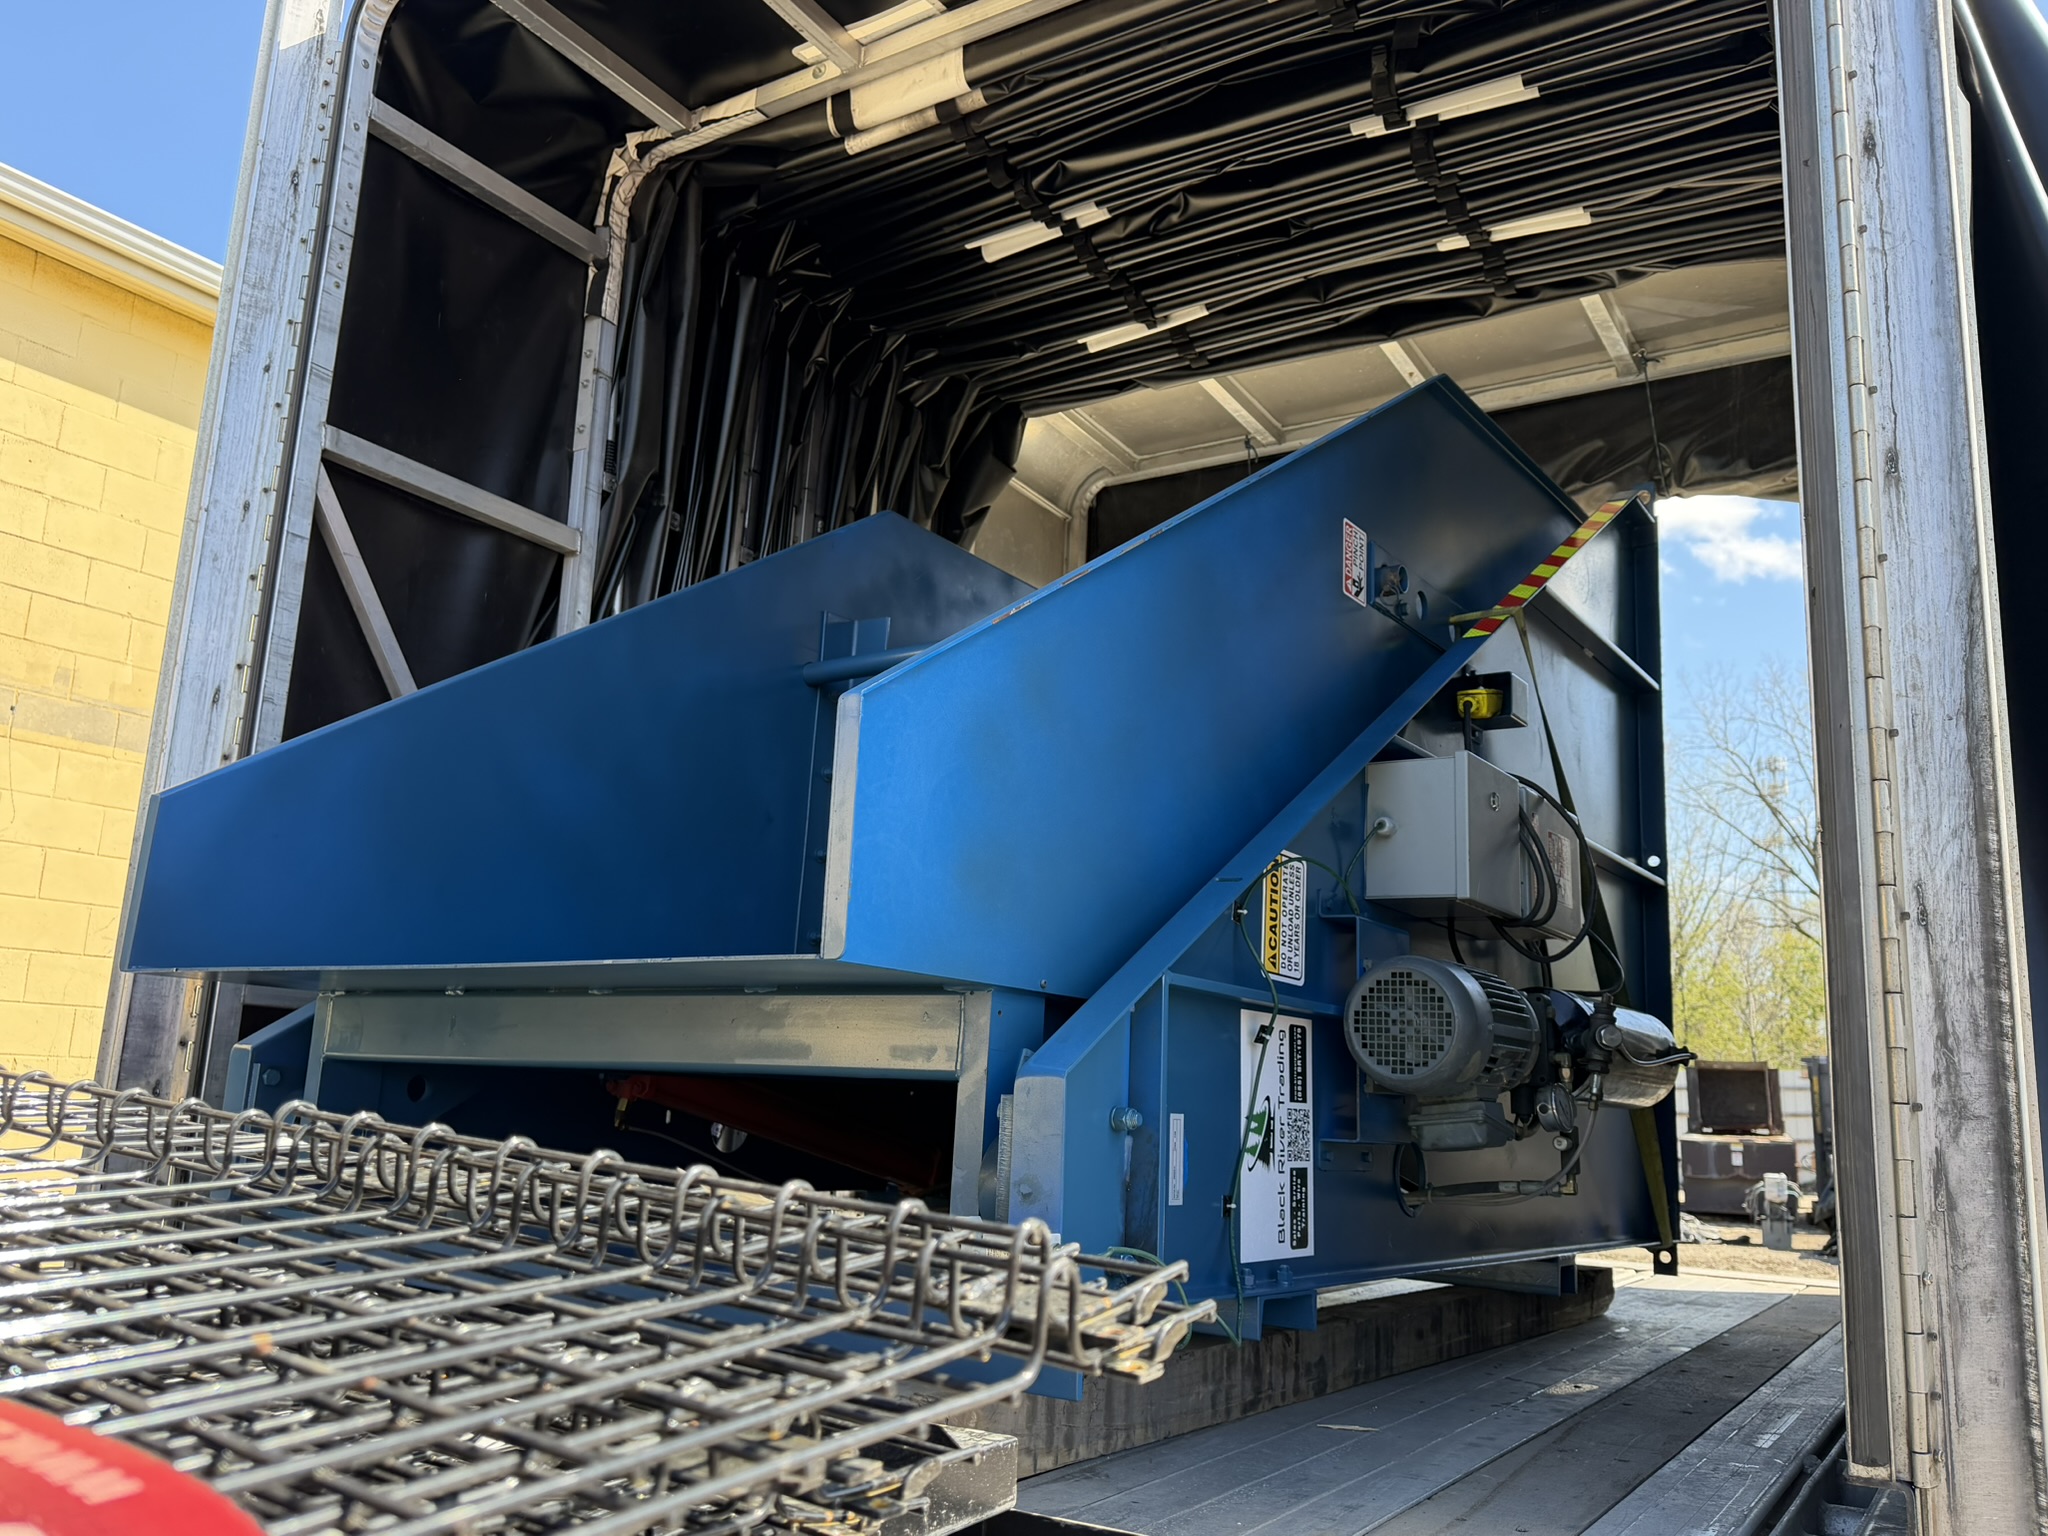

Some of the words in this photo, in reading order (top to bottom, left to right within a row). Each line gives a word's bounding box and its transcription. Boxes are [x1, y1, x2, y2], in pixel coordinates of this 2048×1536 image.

[1345, 525, 1353, 576] DANGER
[1294, 904, 1300, 920] OR
[1281, 952, 1287, 969] DO
[1287, 956, 1293, 972] OR
[1294, 961, 1300, 972] 18
[1277, 1030, 1286, 1110] Trading
[1277, 1182, 1285, 1244] Black
